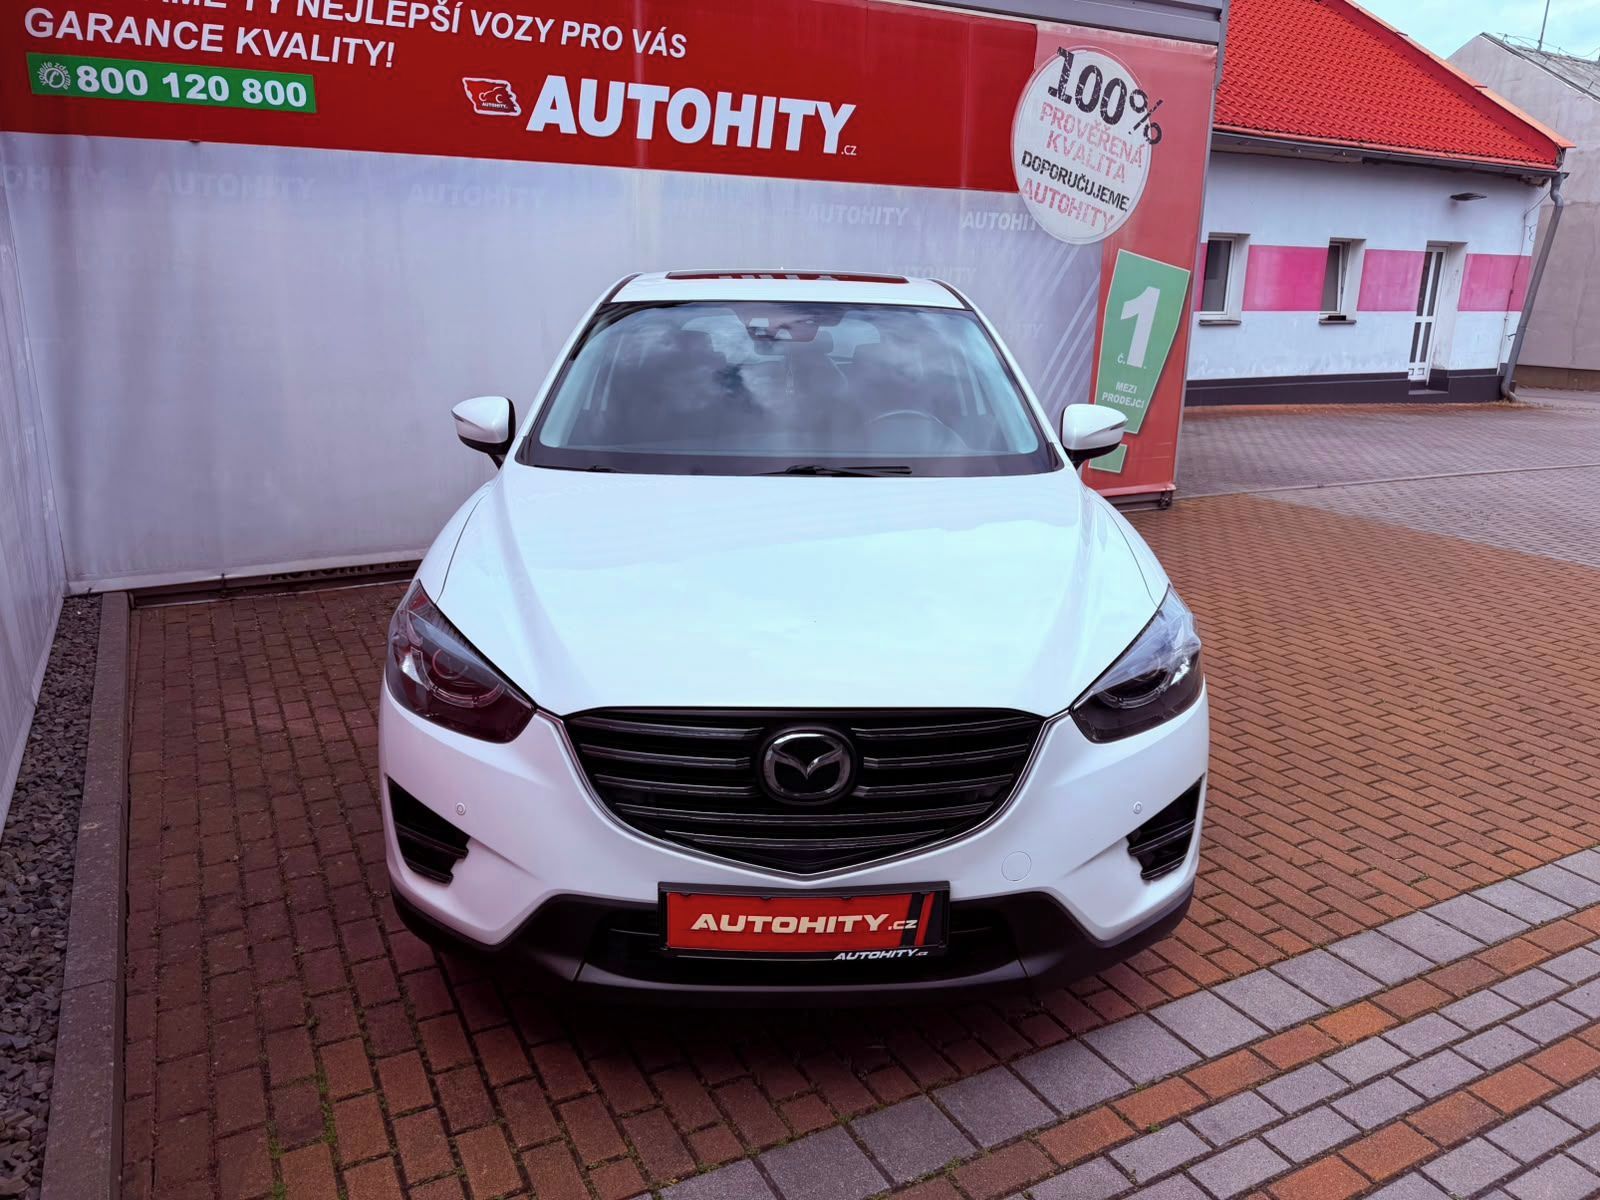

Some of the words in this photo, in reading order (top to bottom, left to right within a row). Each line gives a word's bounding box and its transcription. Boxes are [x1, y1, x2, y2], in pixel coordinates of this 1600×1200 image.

[24, 7, 224, 53] GARANCE
[235, 26, 396, 68] KVALITY!
[296, 0, 463, 33] NEJLEPŠÍ
[470, 10, 555, 45] VOZY
[561, 20, 623, 52] PRO
[632, 26, 688, 59] VÁS
[76, 65, 148, 97] 800
[162, 71, 230, 102] 120
[242, 78, 307, 108] 800
[1047, 46, 1163, 145] 100%
[1040, 102, 1145, 168] PROVĚŘENÁ
[1046, 130, 1126, 183] KVALITA
[1020, 177, 1115, 232] AUTOHITY
[1021, 150, 1130, 212] DOPORUČUJEME
[1102, 391, 1145, 408] PRODEJCI
[1115, 382, 1137, 394] MEZI
